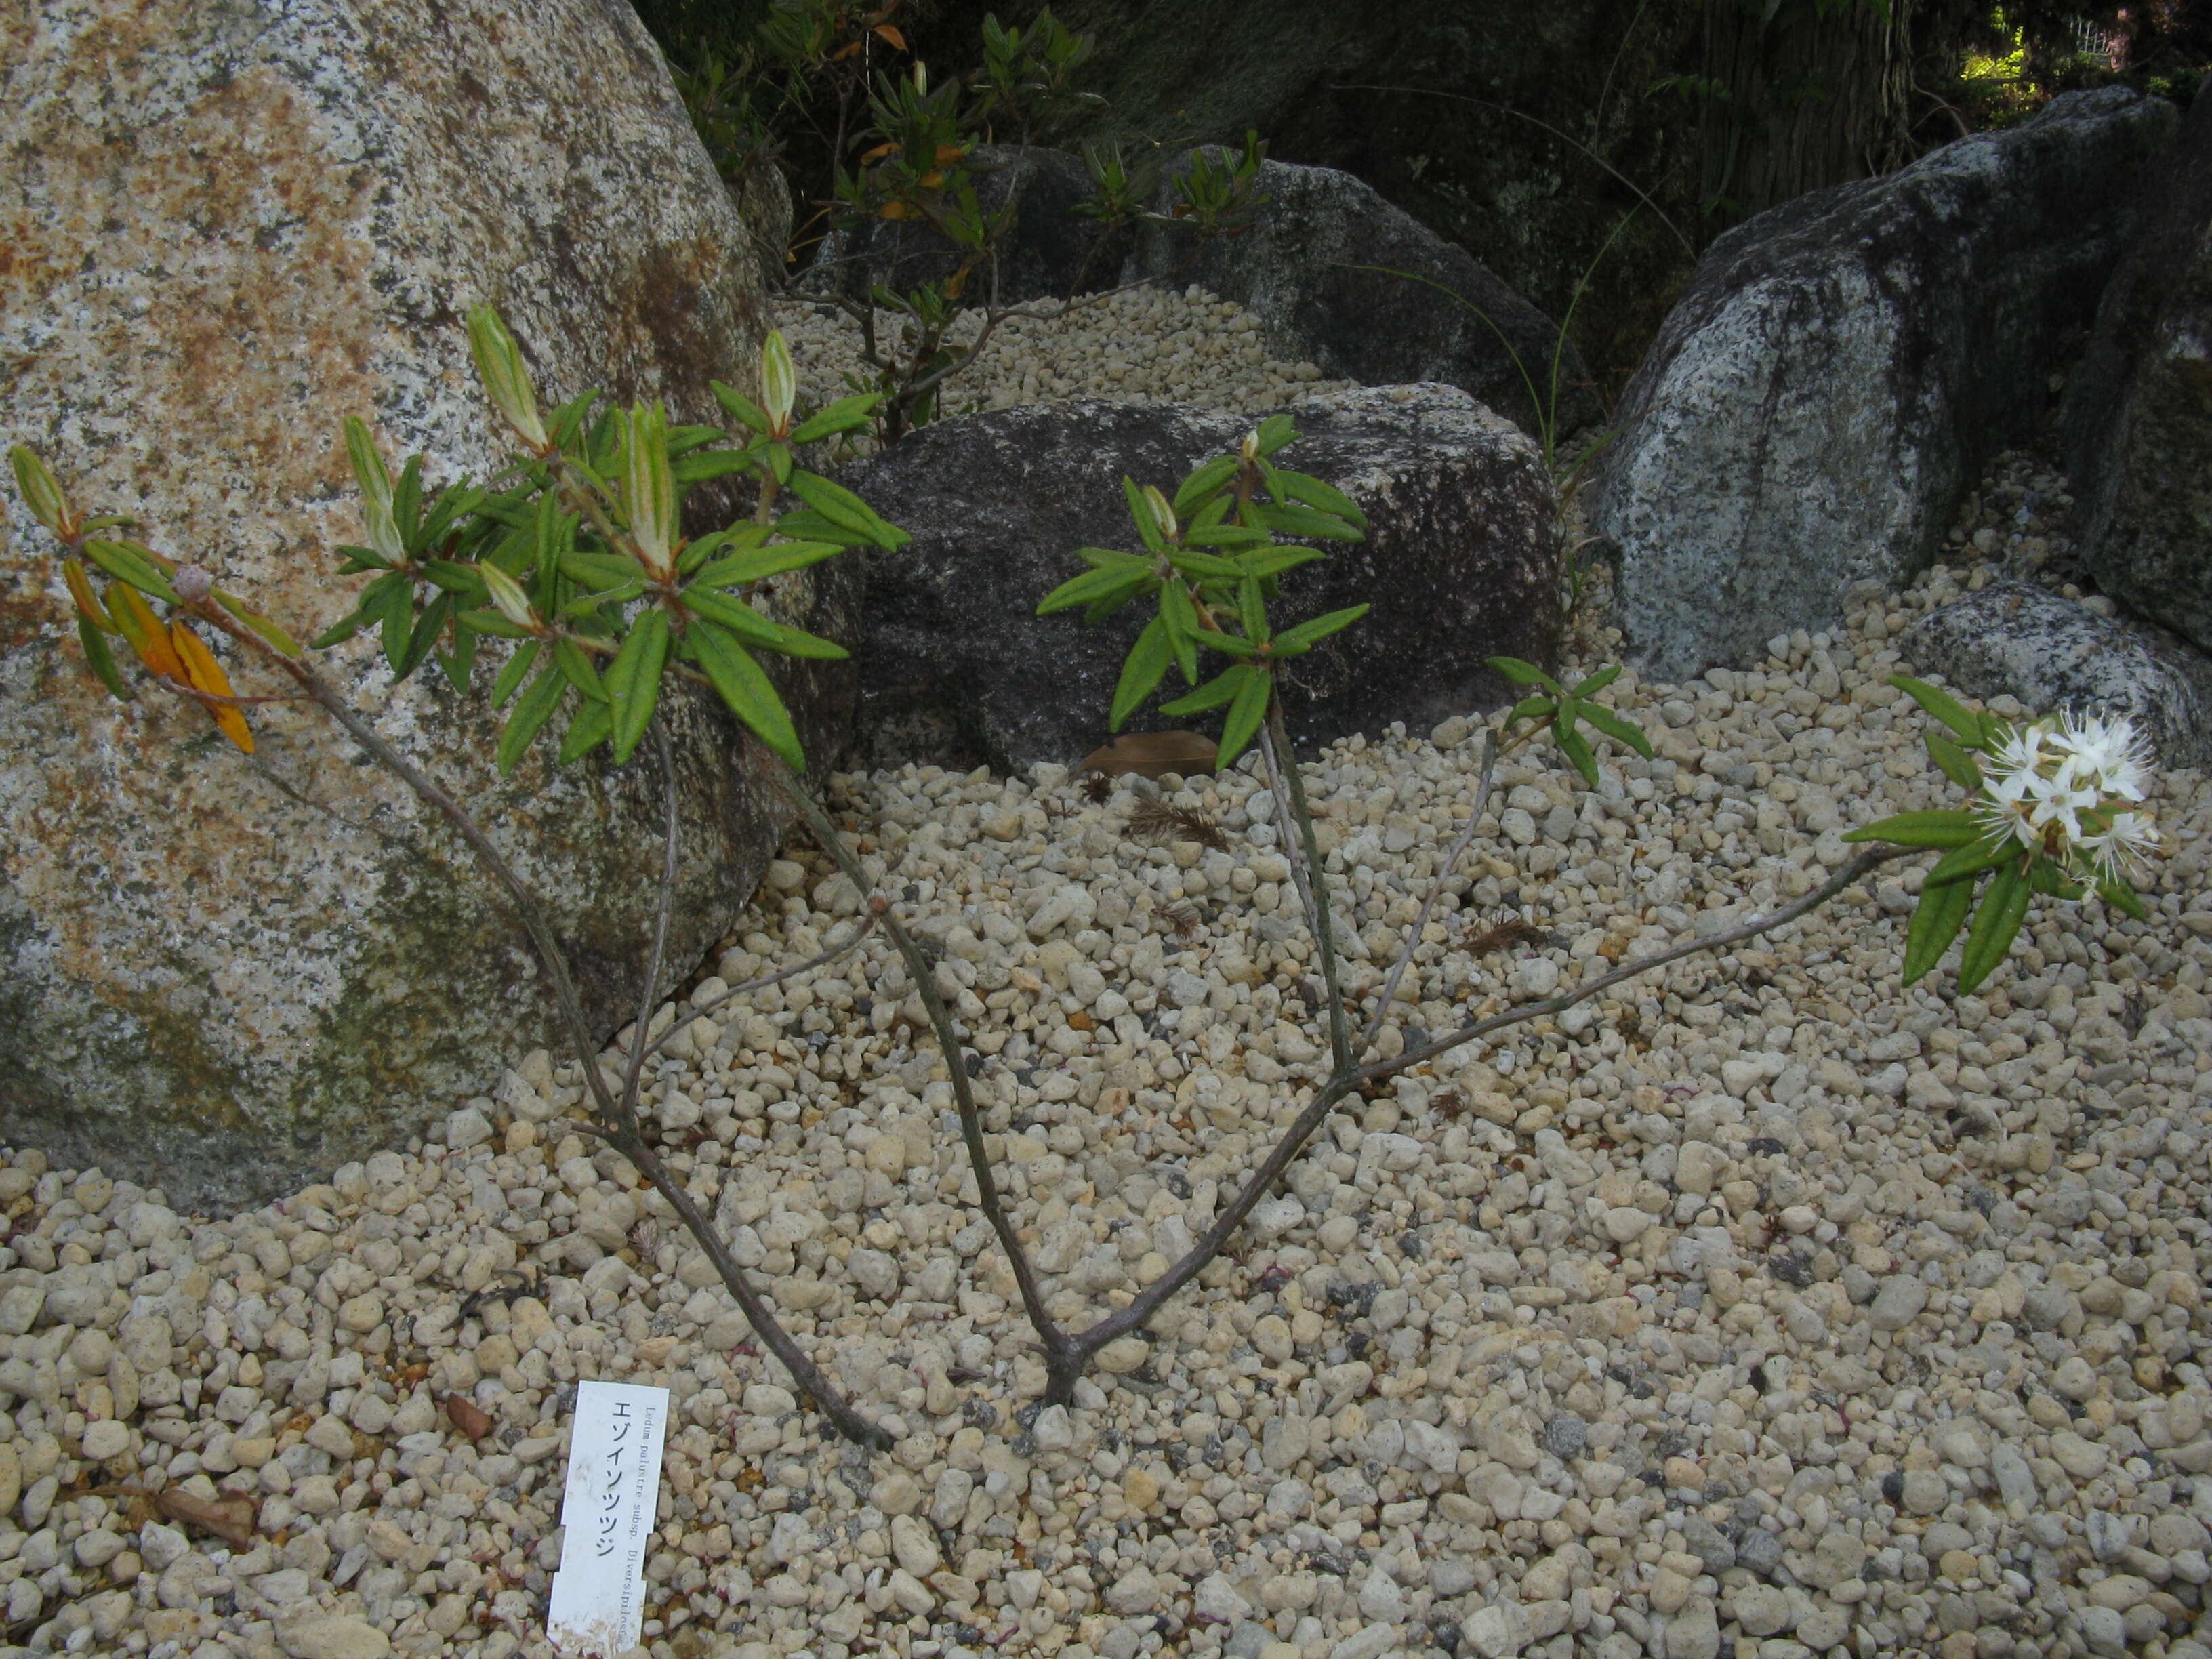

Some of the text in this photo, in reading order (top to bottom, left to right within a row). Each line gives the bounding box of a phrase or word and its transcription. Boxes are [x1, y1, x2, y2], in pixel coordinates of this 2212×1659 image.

[642, 1407, 656, 1440] Ledum
[596, 1402, 631, 1557] エゾイソツツジ
[636, 1445, 649, 1498] palustre
[629, 1504, 642, 1540] subsp.
